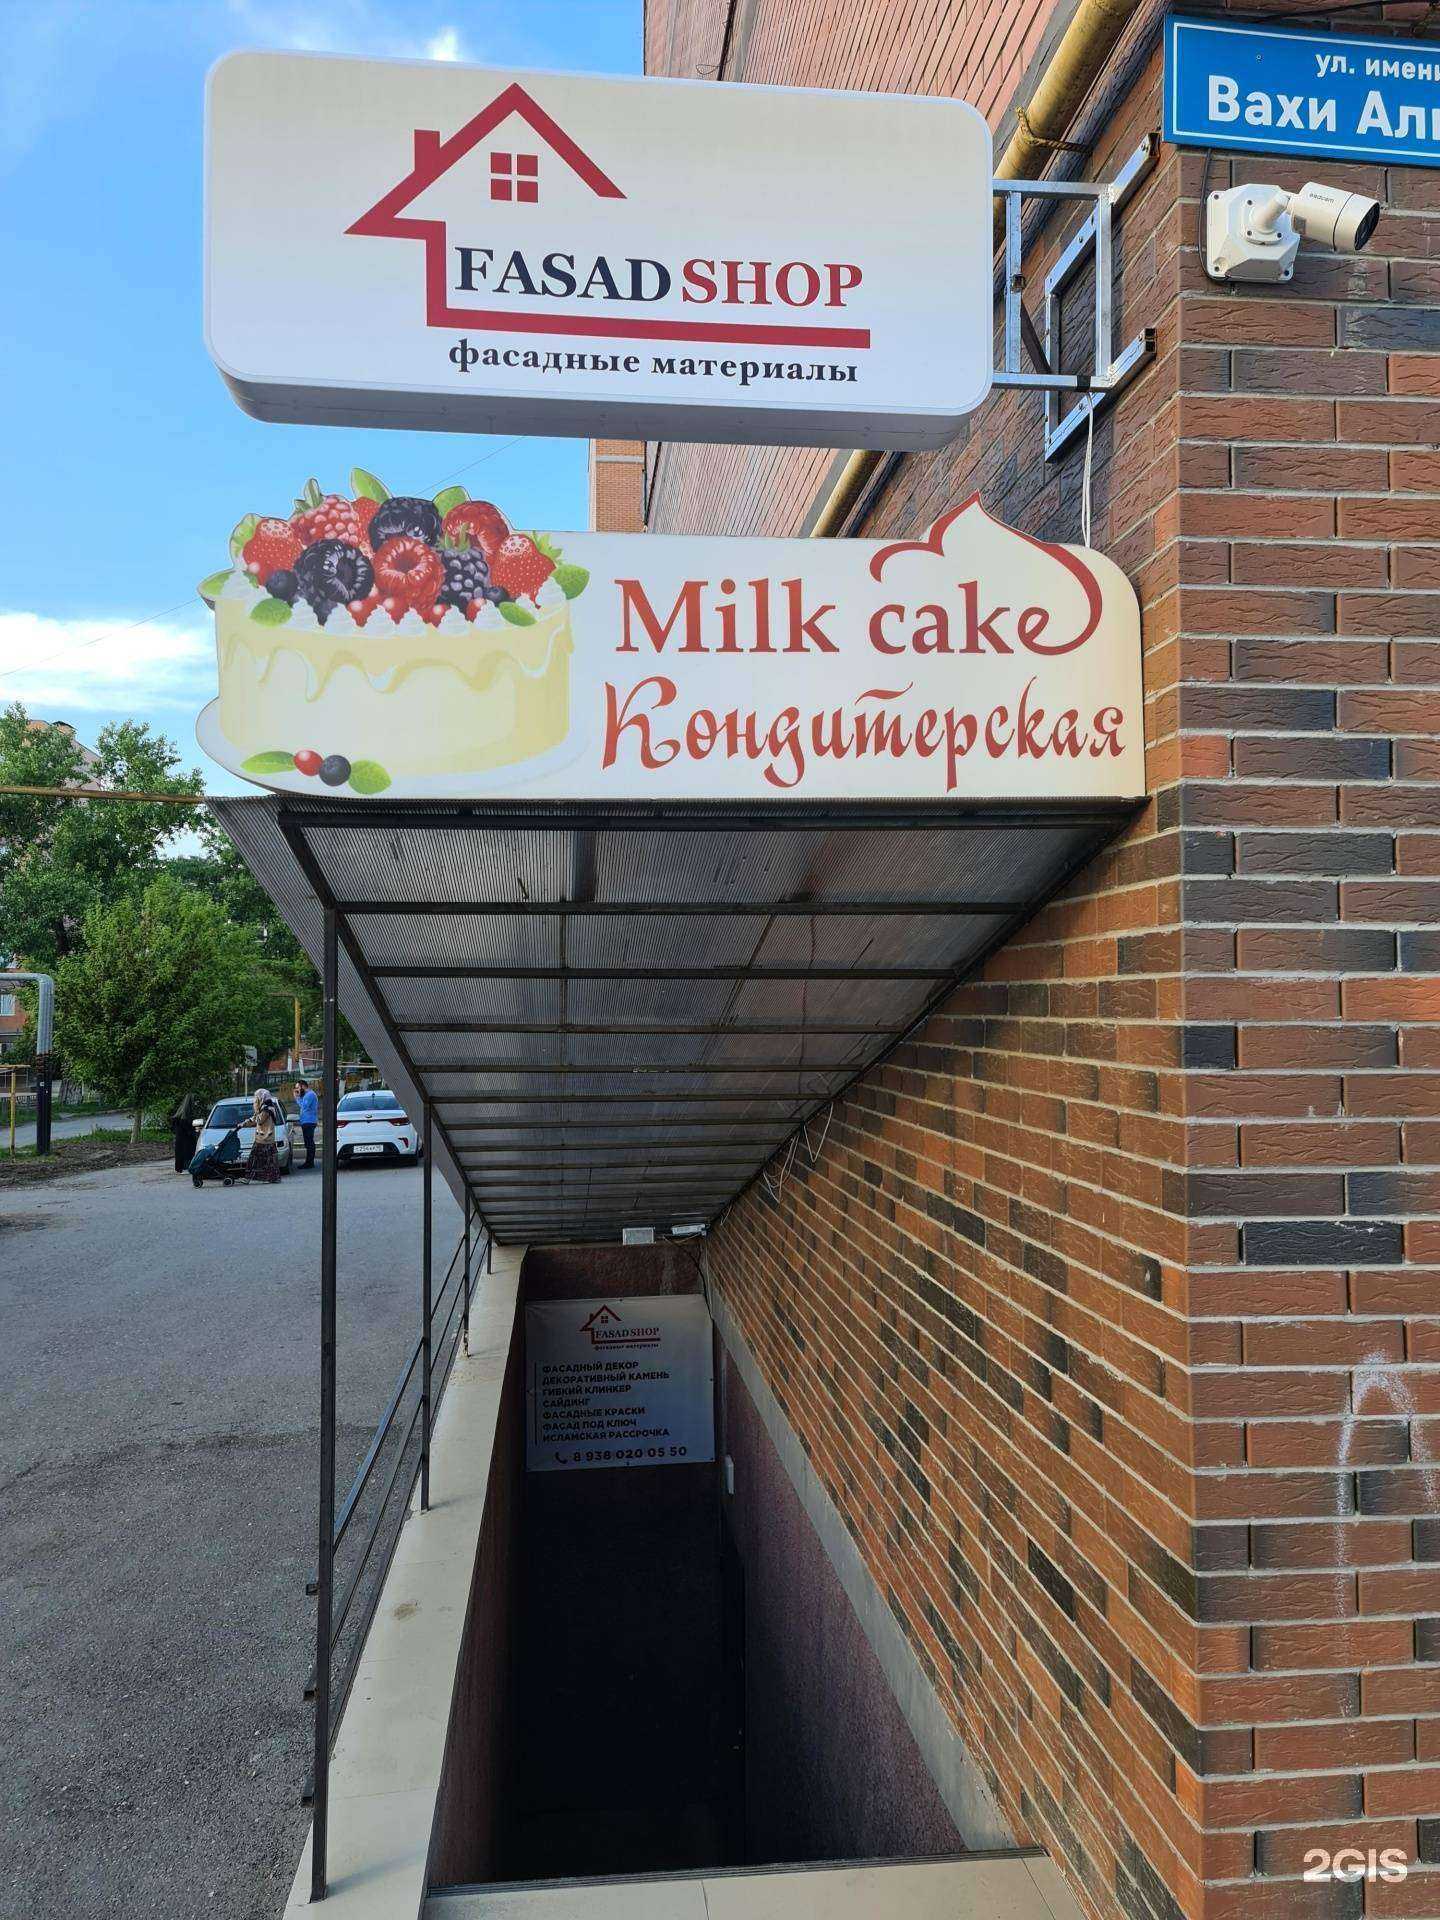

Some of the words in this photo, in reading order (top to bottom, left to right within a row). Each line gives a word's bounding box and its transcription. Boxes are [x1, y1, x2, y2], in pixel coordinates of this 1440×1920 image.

[1316, 54, 1355, 77] ул.
[1208, 75, 1336, 132] Вахи
[449, 338, 640, 373] фасадные
[651, 354, 857, 385] материалы
[615, 577, 839, 653] Milk
[868, 545, 1102, 655] cake
[602, 675, 1126, 793] Кондитерская
[542, 1361, 603, 1374] ФАСАДНЫЙ
[605, 1361, 639, 1372] ДЕКОР
[542, 1372, 626, 1386] ДЕКОРАТИВНЫЙ
[629, 1371, 670, 1381] КАМЕНЬ
[543, 1385, 583, 1397] ГИБКИЙ
[585, 1384, 632, 1394] КЛИНКЕР
[543, 1398, 591, 1409] САЙДИНГ
[543, 1408, 602, 1419] ФАСАДНЫЕ
[605, 1406, 646, 1416] КРАСКИ
[543, 1420, 580, 1431] ФАСАД
[582, 1420, 604, 1430] ПОД
[606, 1418, 637, 1428] КЛЮЧ
[543, 1431, 607, 1442] ИСЛАМСКАЯ
[608, 1428, 670, 1439] РАССРОЧКА
[574, 1452, 581, 1461] 8
[586, 1450, 611, 1460] 938
[616, 1449, 643, 1459] 020
[647, 1447, 665, 1458] 05
[670, 1446, 687, 1456] 50
